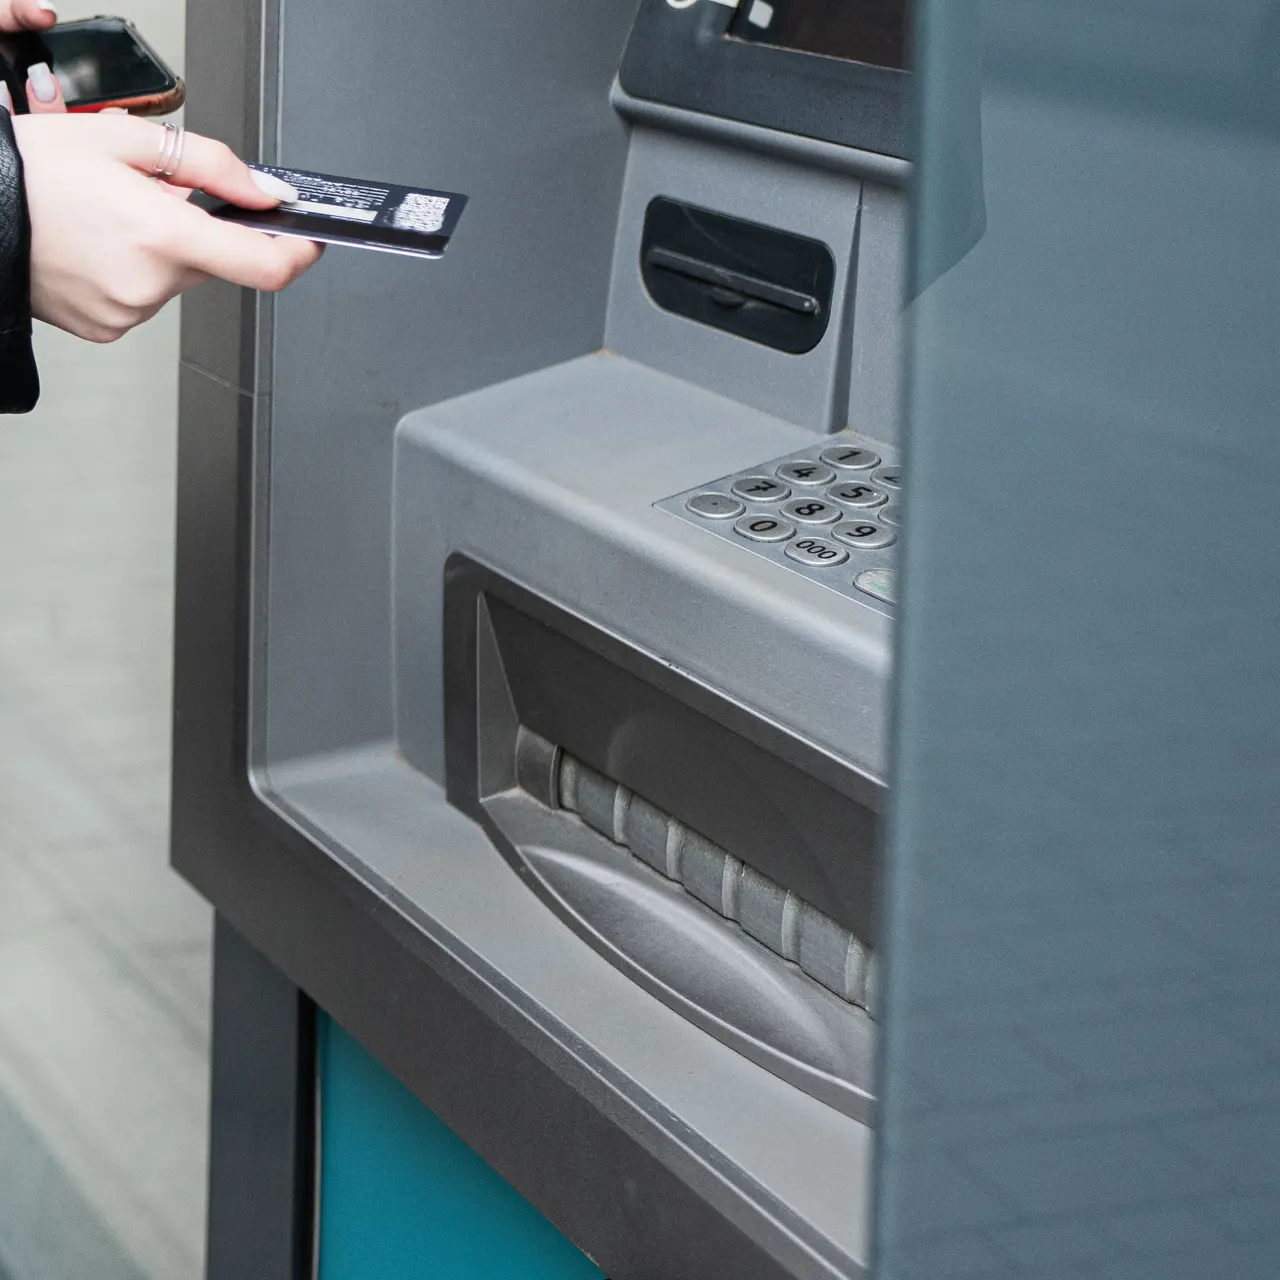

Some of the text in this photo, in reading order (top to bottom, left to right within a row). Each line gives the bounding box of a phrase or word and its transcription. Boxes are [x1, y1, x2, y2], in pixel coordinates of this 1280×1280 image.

[838, 450, 861, 461] 1
[794, 467, 817, 478] 4
[746, 481, 777, 493] 7
[840, 486, 873, 499] 5
[795, 503, 825, 516] 8
[749, 520, 777, 532] 0
[845, 525, 877, 538] 9
[796, 540, 837, 560] 000
